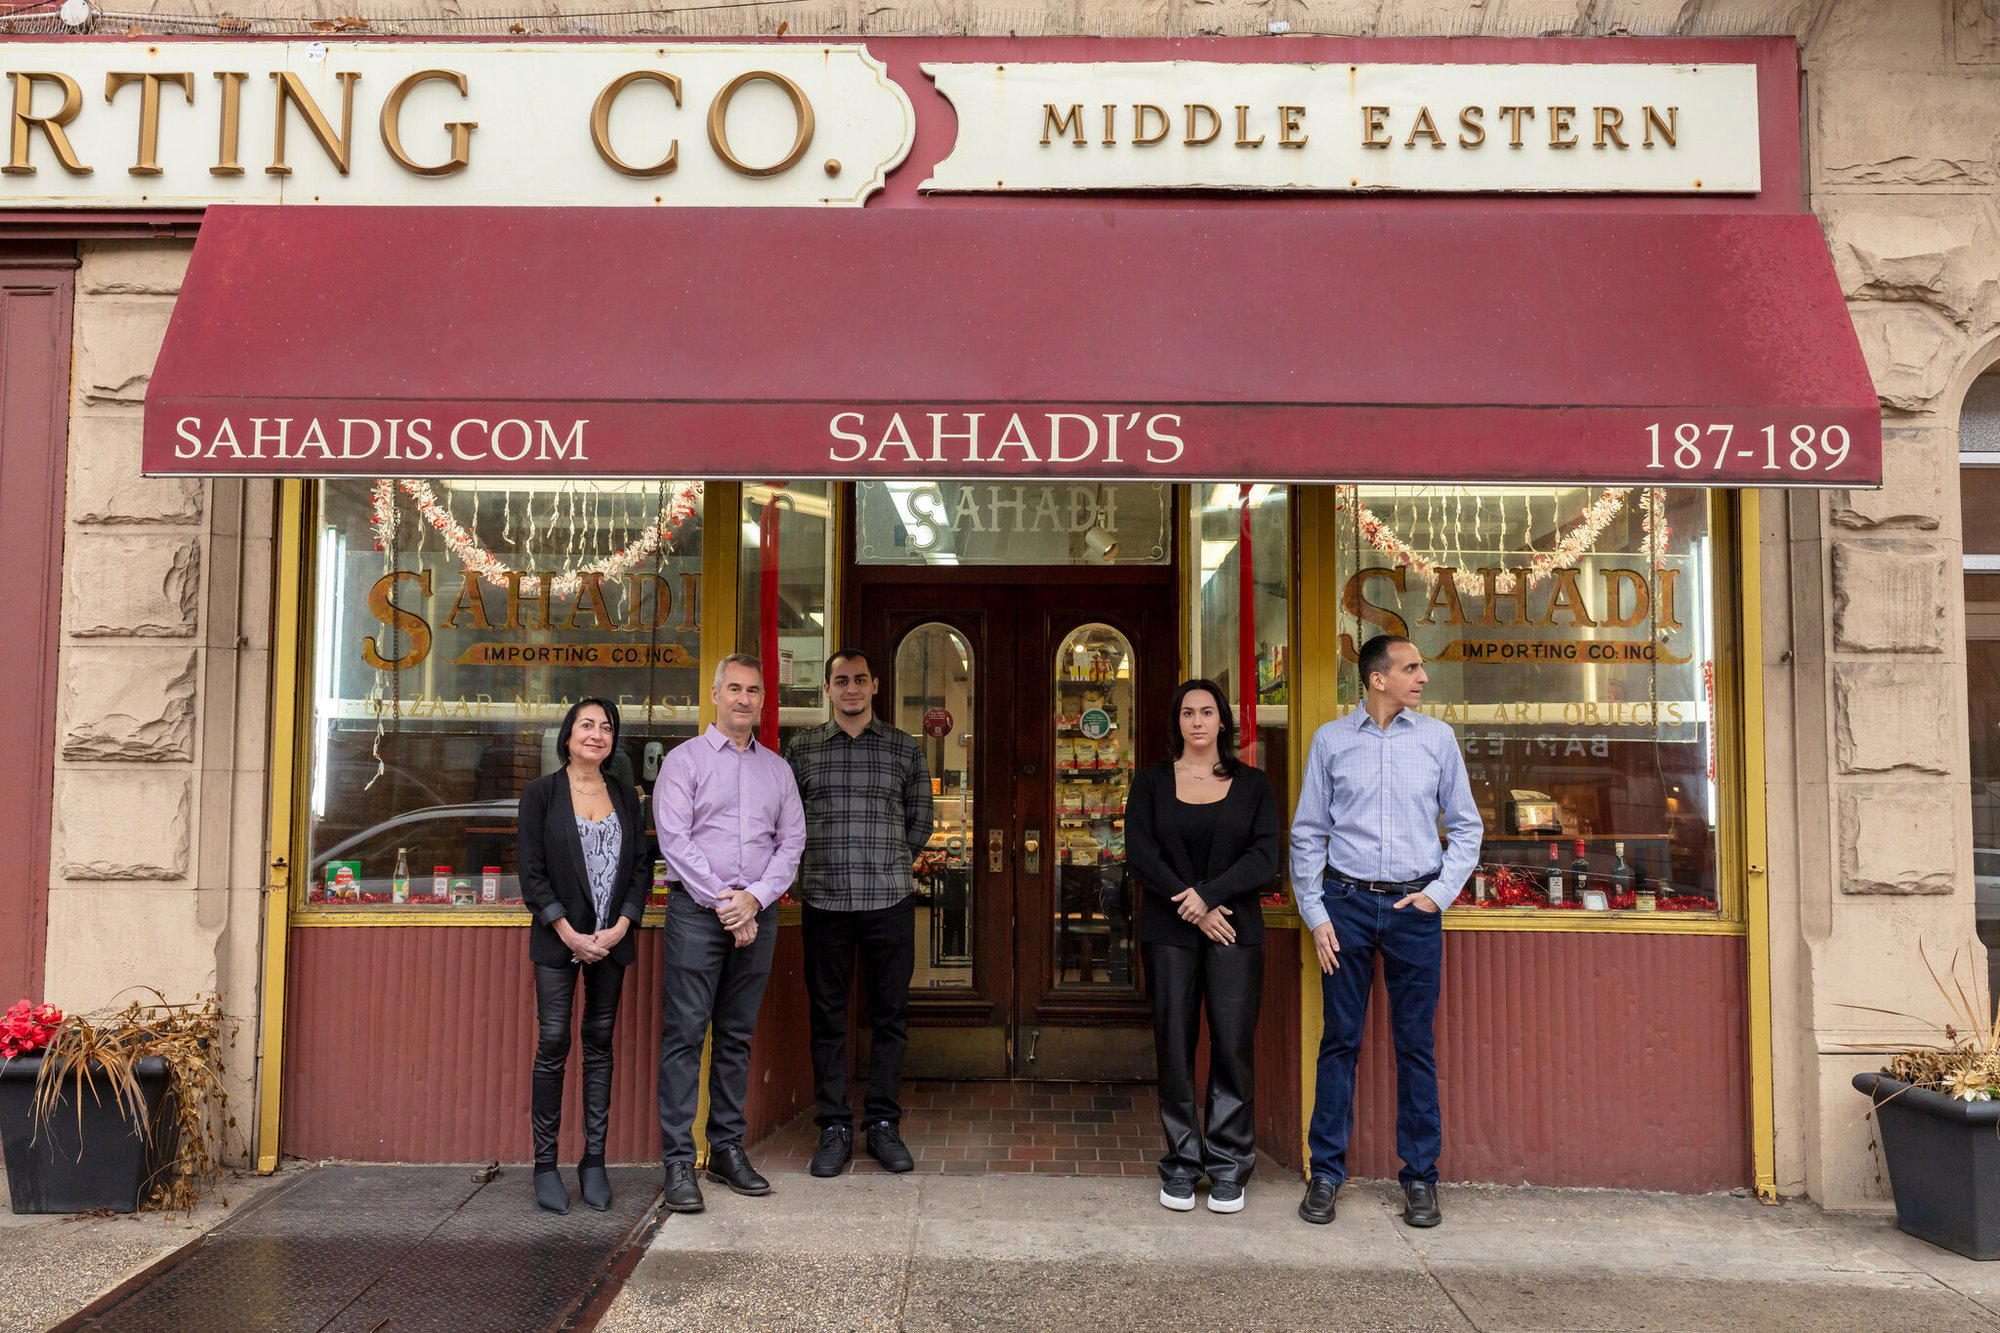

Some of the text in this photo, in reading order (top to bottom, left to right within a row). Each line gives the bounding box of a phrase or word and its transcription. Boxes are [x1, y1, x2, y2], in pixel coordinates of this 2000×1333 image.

[2, 69, 842, 177] RTING CO.
[1039, 103, 1679, 149] MIDDLE EASTERN
[174, 416, 590, 461] SAHADIS.COM
[828, 410, 1186, 463] SAHADI'S
[1644, 421, 1851, 471] 187-189
[904, 485, 1119, 552] SAHADI
[361, 568, 701, 670] SAHADI
[1339, 565, 1683, 664] SAHADI
[484, 646, 599, 663] IMPORTING
[611, 647, 641, 663] CO.
[1462, 643, 1660, 661] IMPORTING CO. INC.
[363, 693, 493, 718] BAZAAR
[514, 694, 595, 719] NEA
